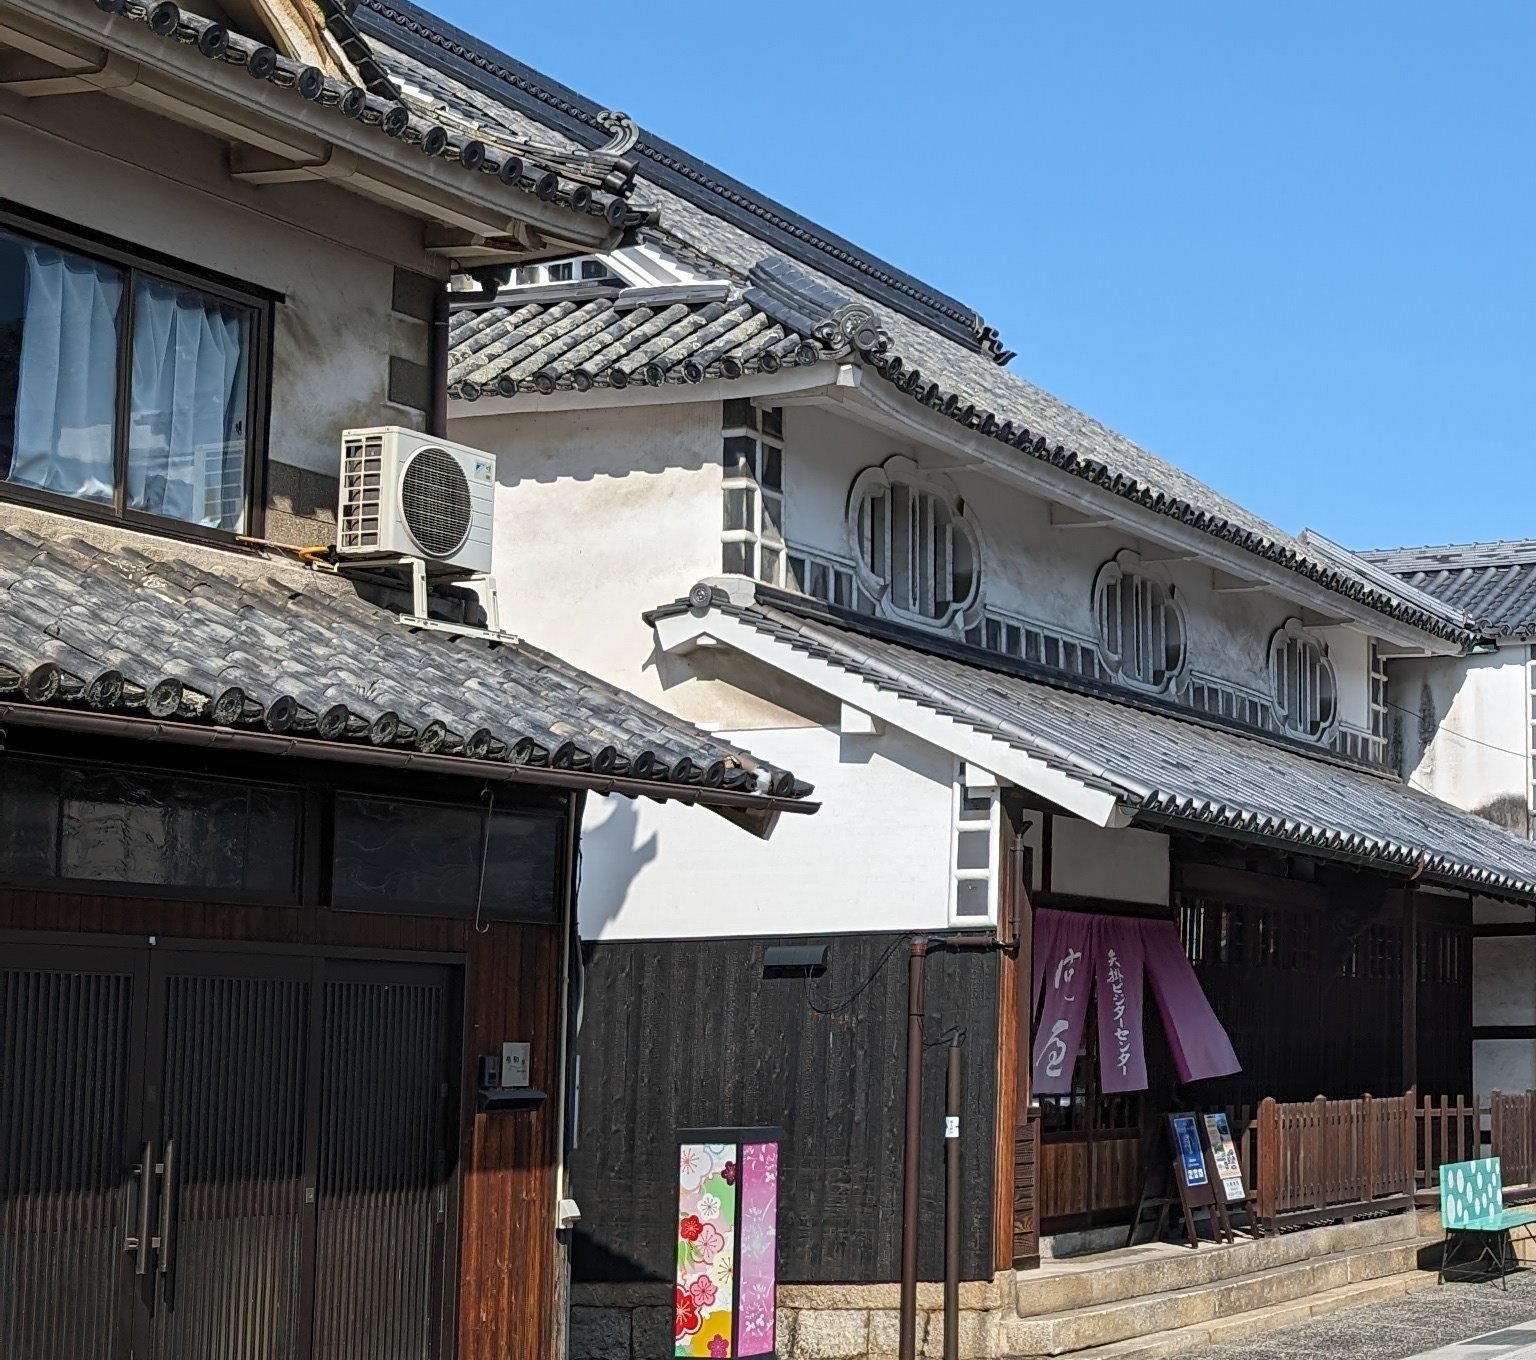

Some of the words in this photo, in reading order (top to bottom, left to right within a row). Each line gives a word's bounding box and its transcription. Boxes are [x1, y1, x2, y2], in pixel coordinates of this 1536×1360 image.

[1107, 948, 1131, 1076] 矢掛ビジターセンター
